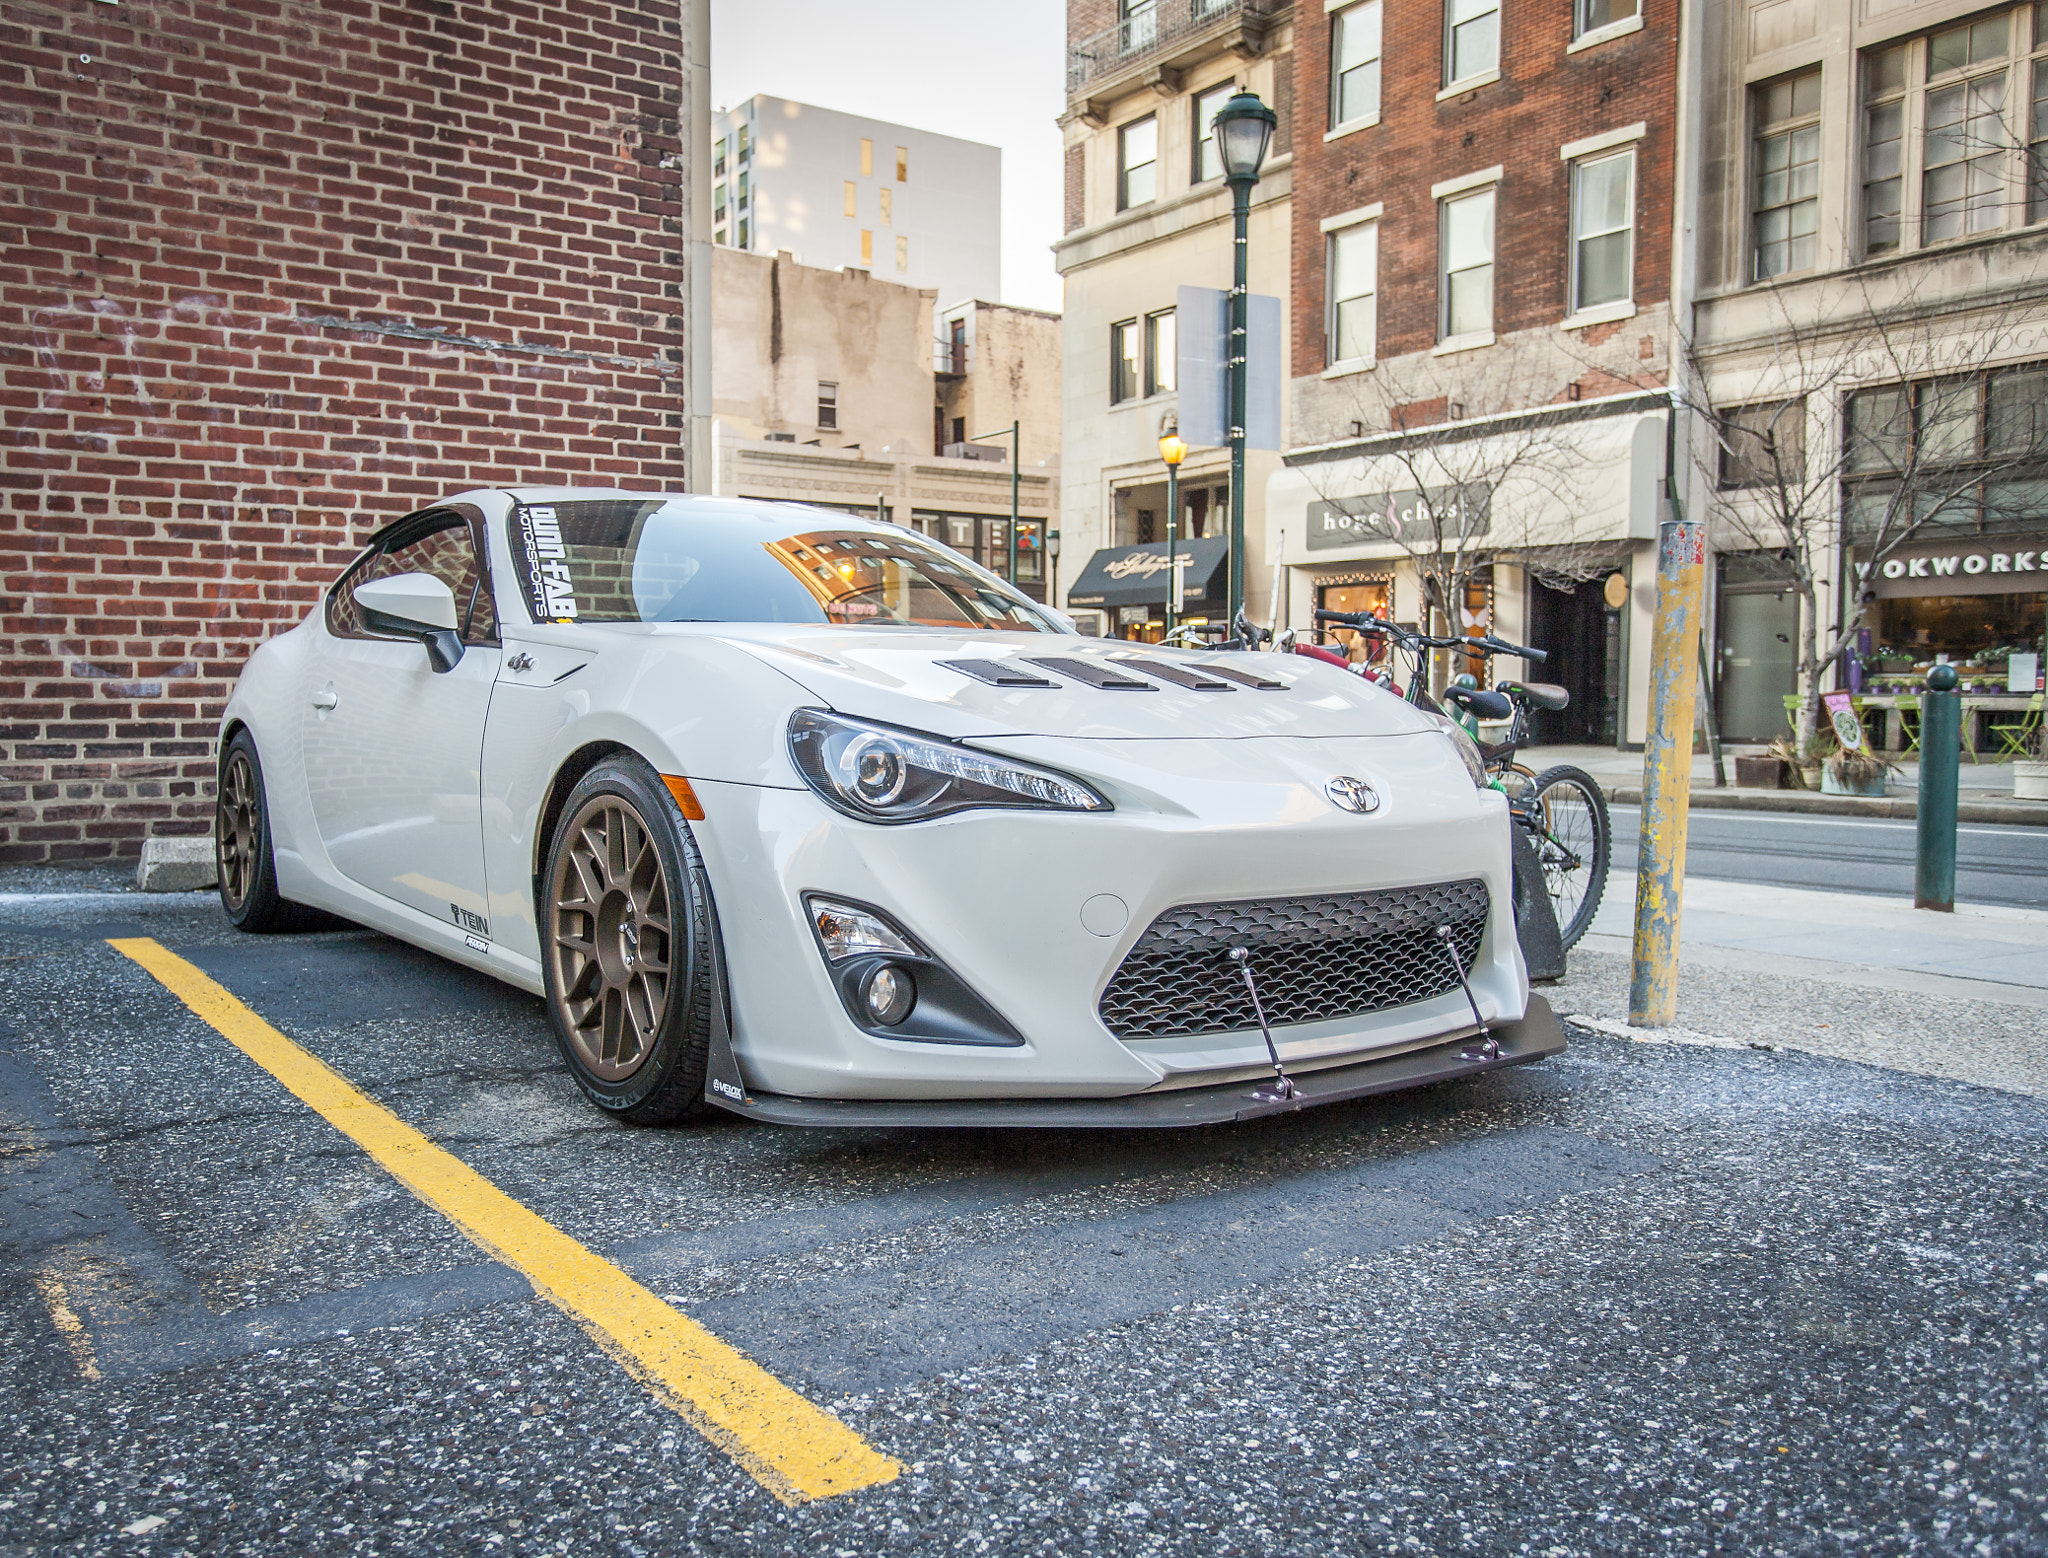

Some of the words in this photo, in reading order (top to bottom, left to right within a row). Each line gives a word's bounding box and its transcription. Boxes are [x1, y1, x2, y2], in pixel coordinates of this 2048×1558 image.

[518, 507, 548, 617] MOTORSPORTS
[460, 908, 489, 935] TEIN
[719, 1081, 742, 1099] VELOX
